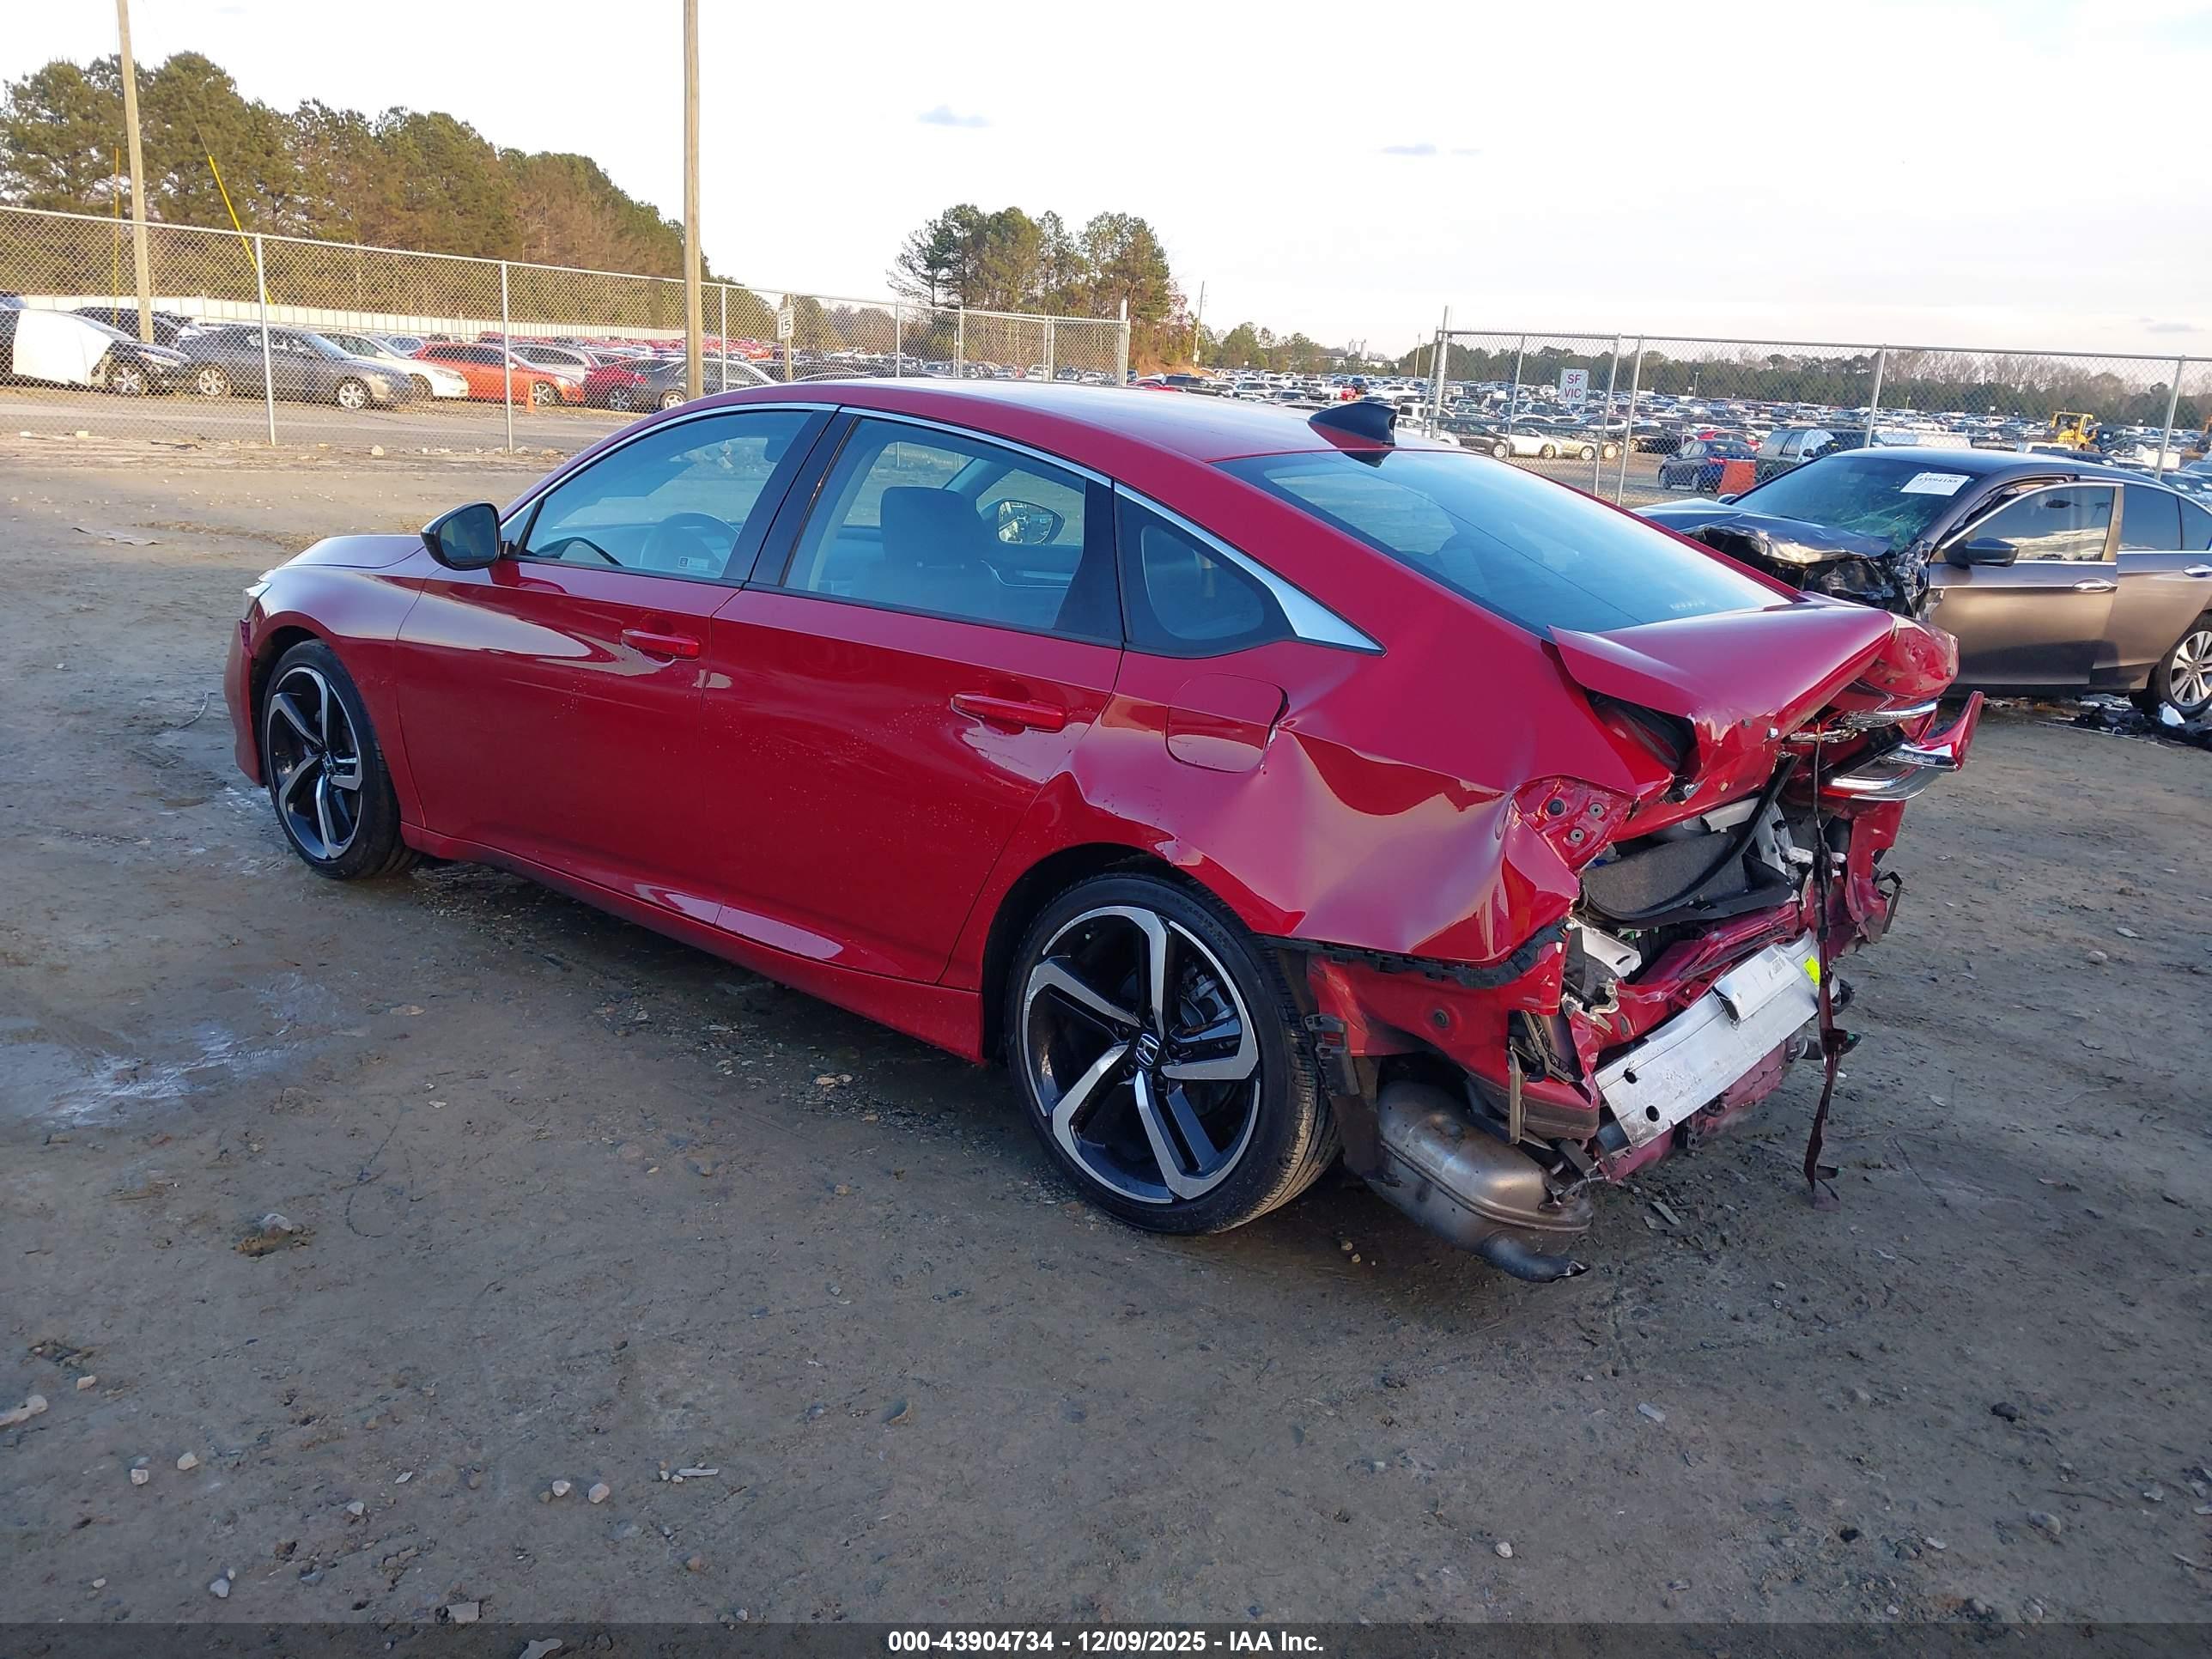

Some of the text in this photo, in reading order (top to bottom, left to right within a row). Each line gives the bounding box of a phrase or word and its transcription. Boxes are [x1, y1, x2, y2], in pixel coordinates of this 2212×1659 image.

[781, 320, 791, 332] 15
[1567, 374, 1582, 385] SF
[1565, 388, 1582, 398] VIC
